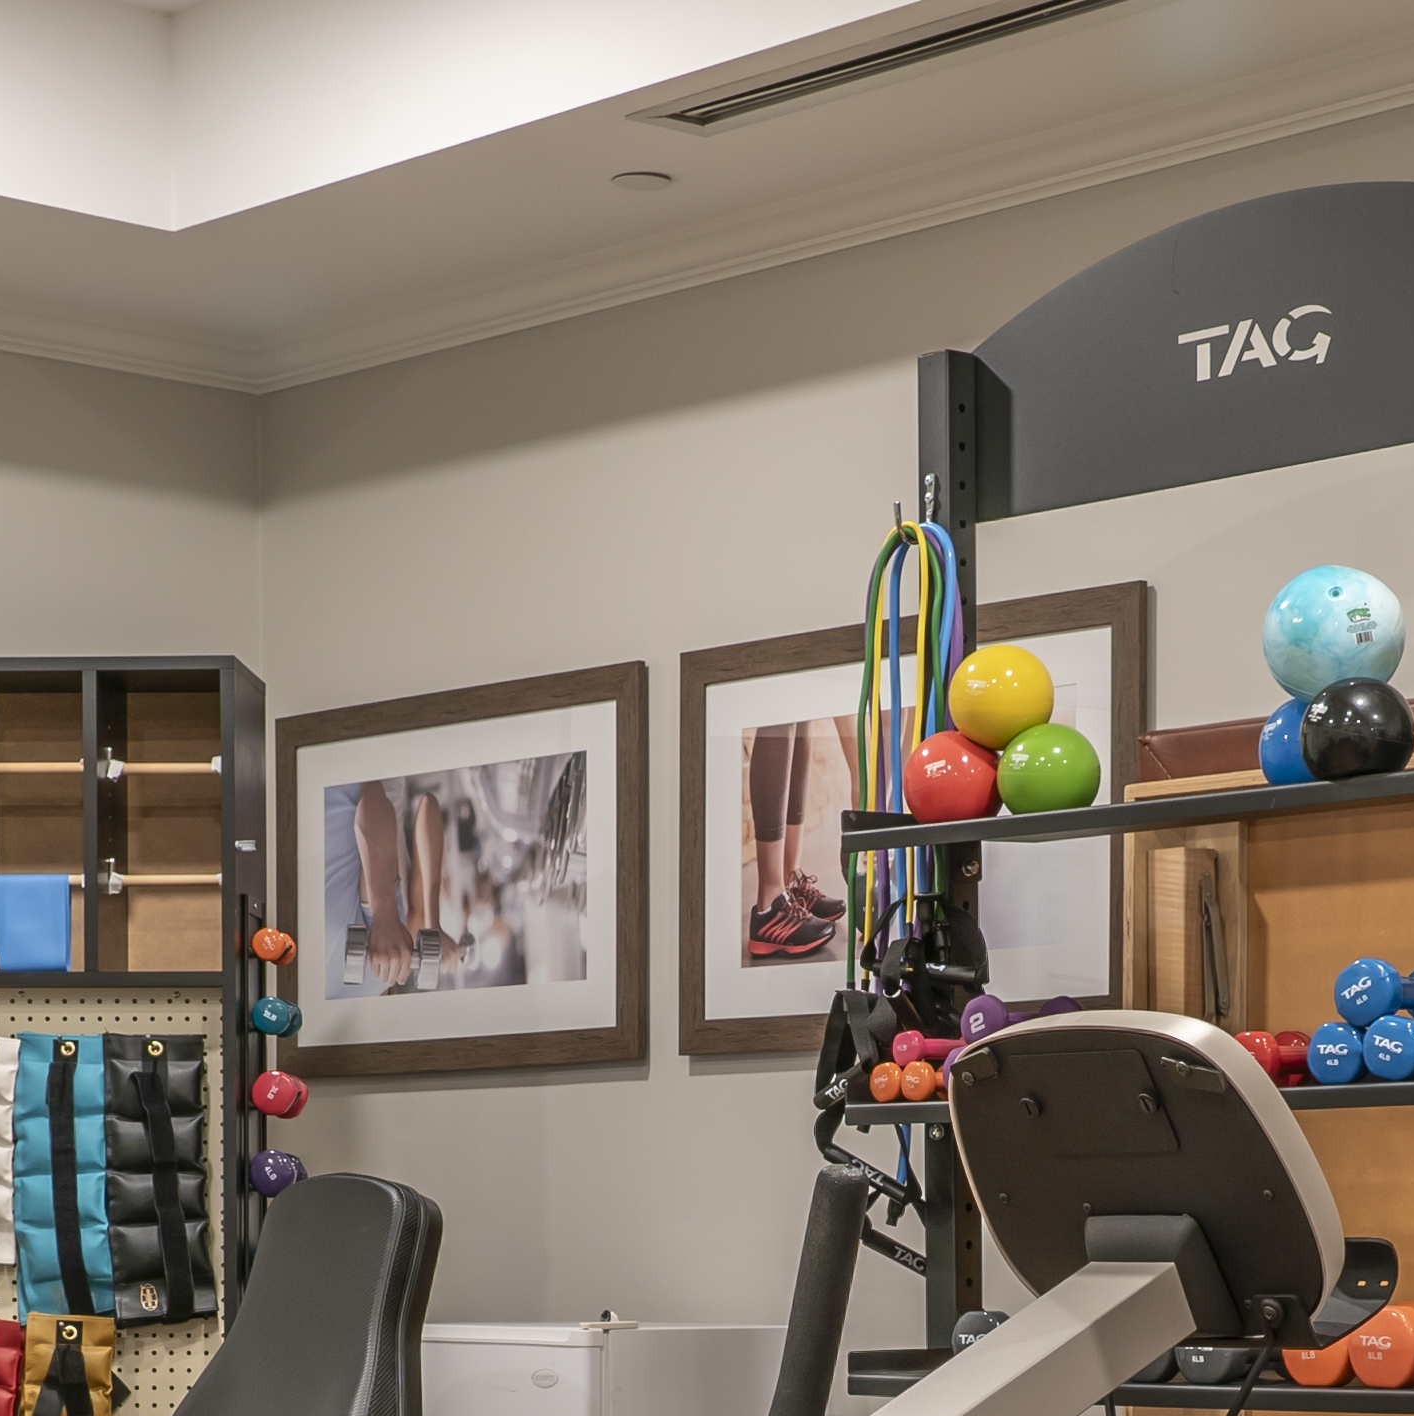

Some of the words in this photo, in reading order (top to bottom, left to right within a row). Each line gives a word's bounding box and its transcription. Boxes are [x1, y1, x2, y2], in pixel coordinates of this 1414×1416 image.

[1178, 304, 1332, 382] TAG
[1341, 975, 1372, 1000] TAG
[1355, 994, 1369, 1006] 4LB
[969, 1012, 985, 1034] 2
[1316, 1043, 1349, 1056] TAG
[1372, 1034, 1403, 1054] TAG
[1378, 1052, 1391, 1062] 4LB
[824, 1078, 848, 1100] TAG
[264, 1166, 278, 1181] 4LB
[851, 1158, 885, 1187] TAG
[894, 1246, 925, 1271] TAG
[1359, 1335, 1392, 1349] TAG
